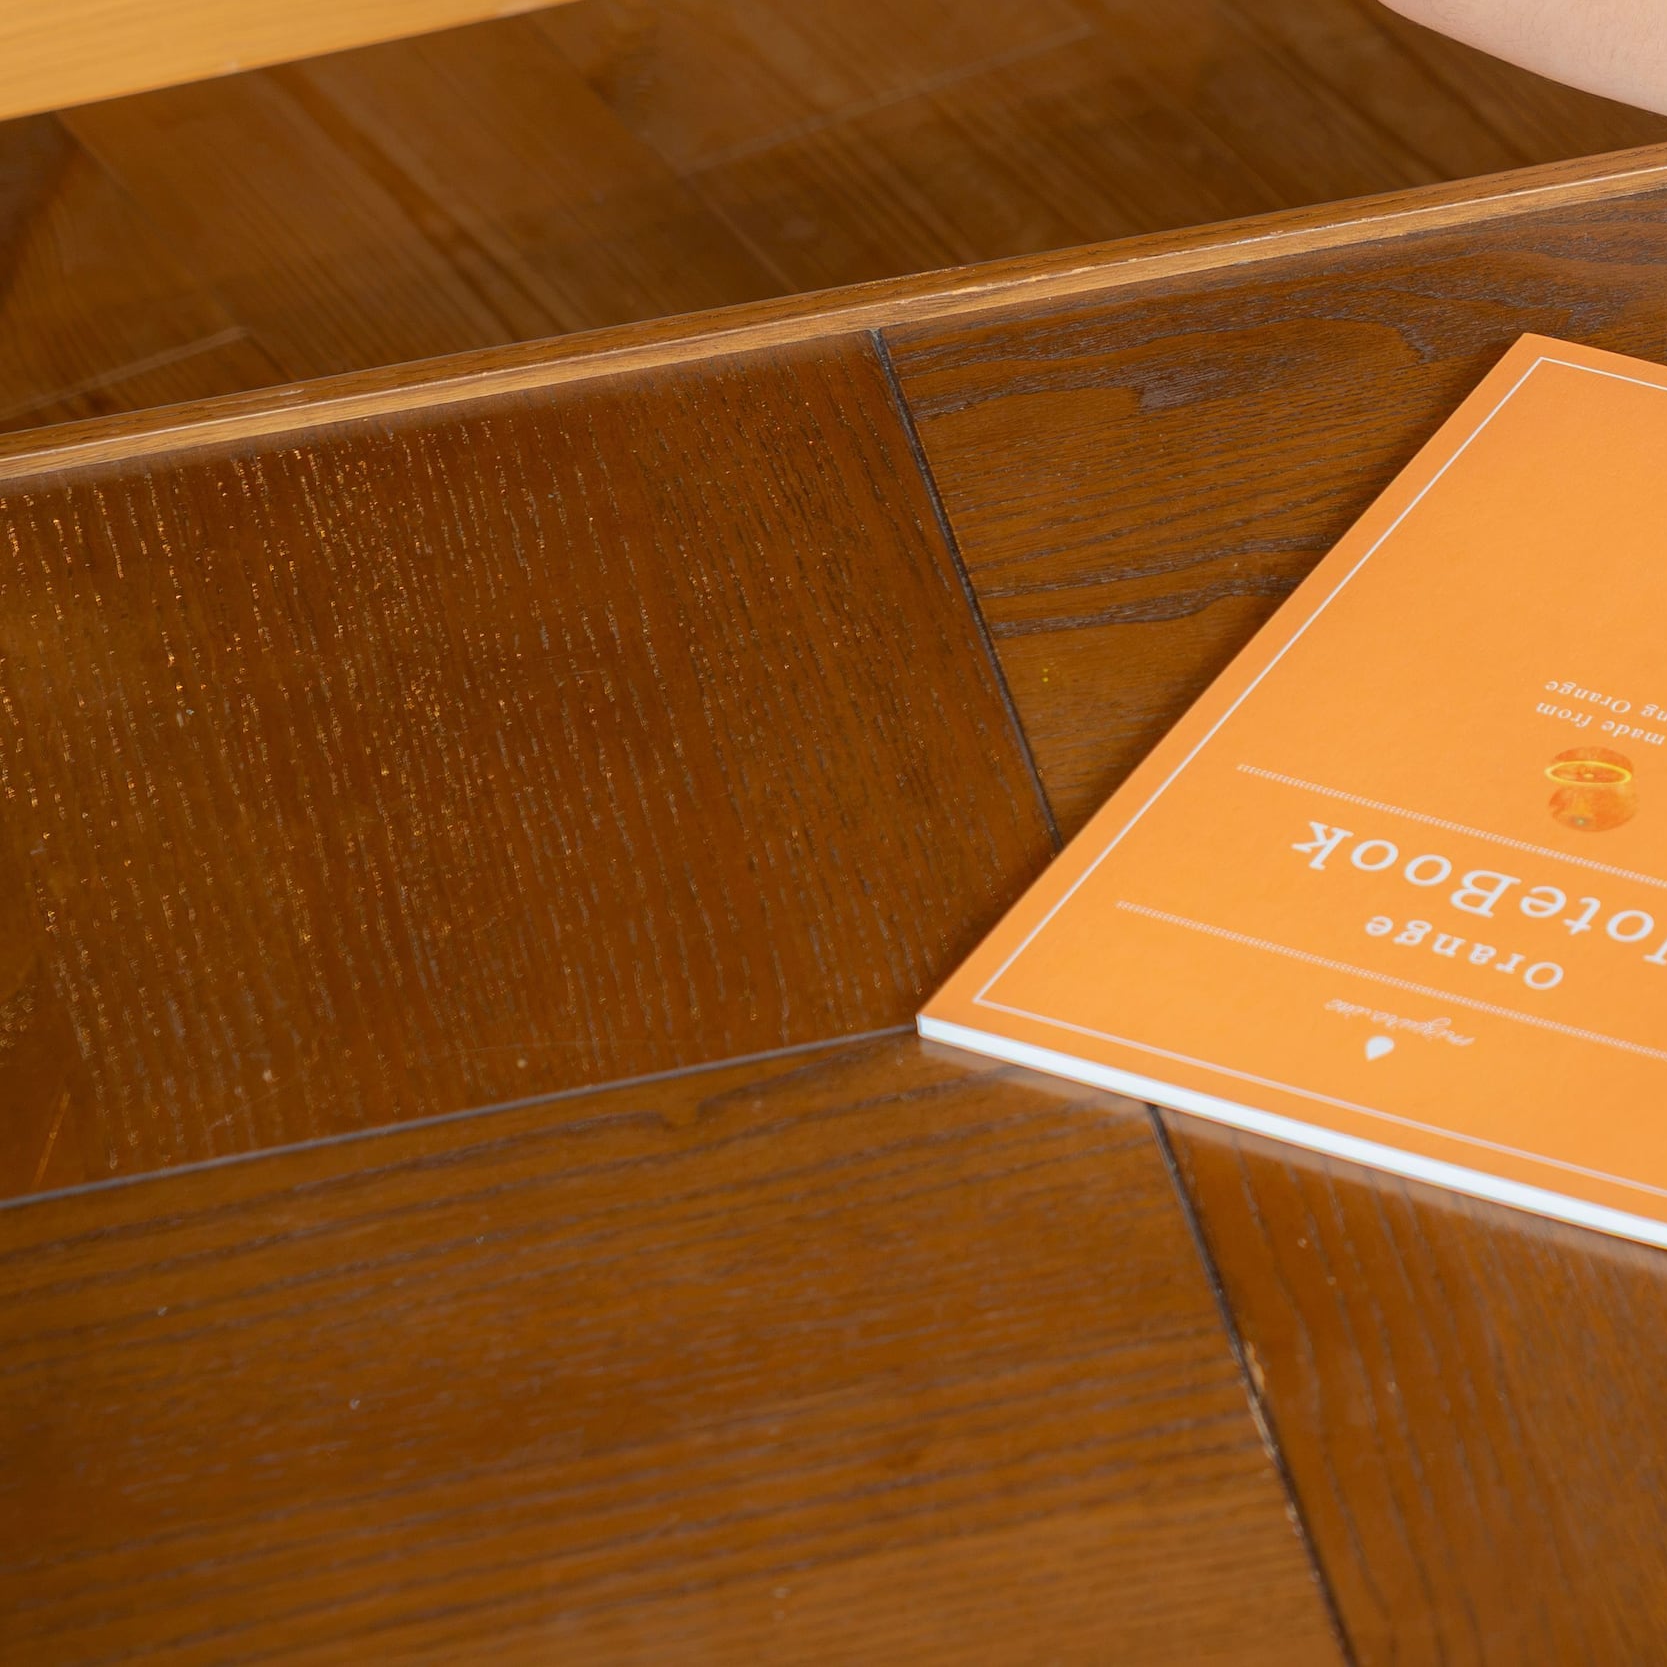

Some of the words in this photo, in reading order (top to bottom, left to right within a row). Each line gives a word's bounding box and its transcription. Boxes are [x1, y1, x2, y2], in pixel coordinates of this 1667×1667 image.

[1544, 680, 1632, 715] Orange
[1535, 701, 1594, 729] from
[1600, 719, 1666, 747] made
[1364, 915, 1565, 991] Orange
